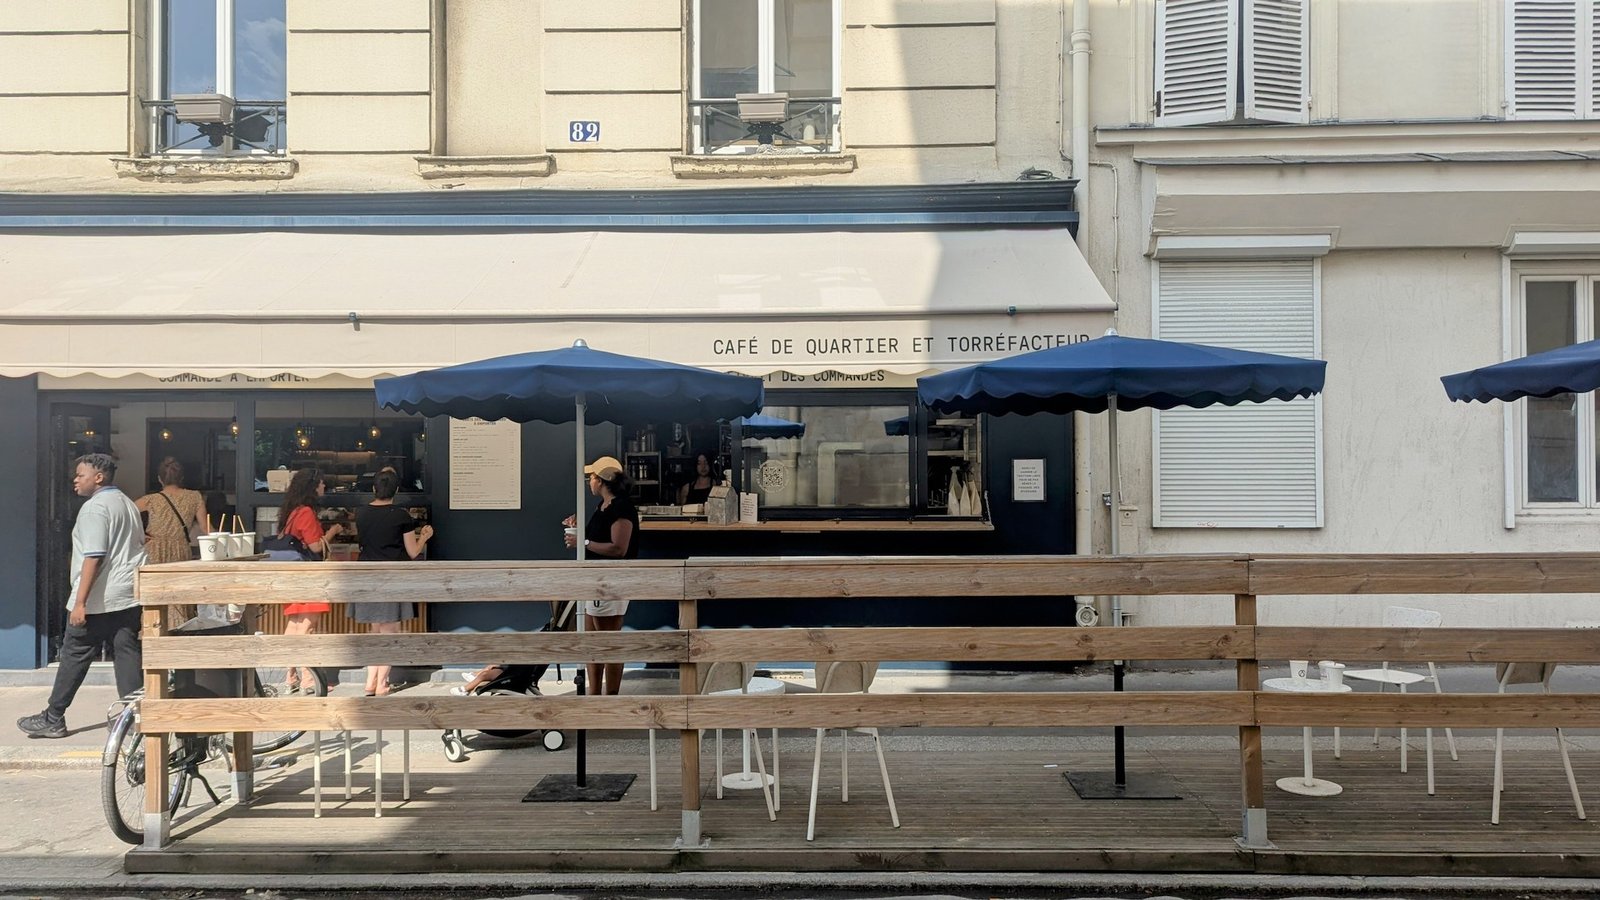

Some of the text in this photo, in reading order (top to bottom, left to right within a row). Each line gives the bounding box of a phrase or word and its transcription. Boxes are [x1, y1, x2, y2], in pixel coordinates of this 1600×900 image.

[572, 122, 598, 141] 82
[713, 336, 758, 355] CAFÉ
[772, 339, 793, 355] DE
[806, 338, 899, 356] QUARTIER
[912, 337, 934, 353] ET
[782, 371, 805, 382] DES
[813, 370, 885, 382] COMMANDES
